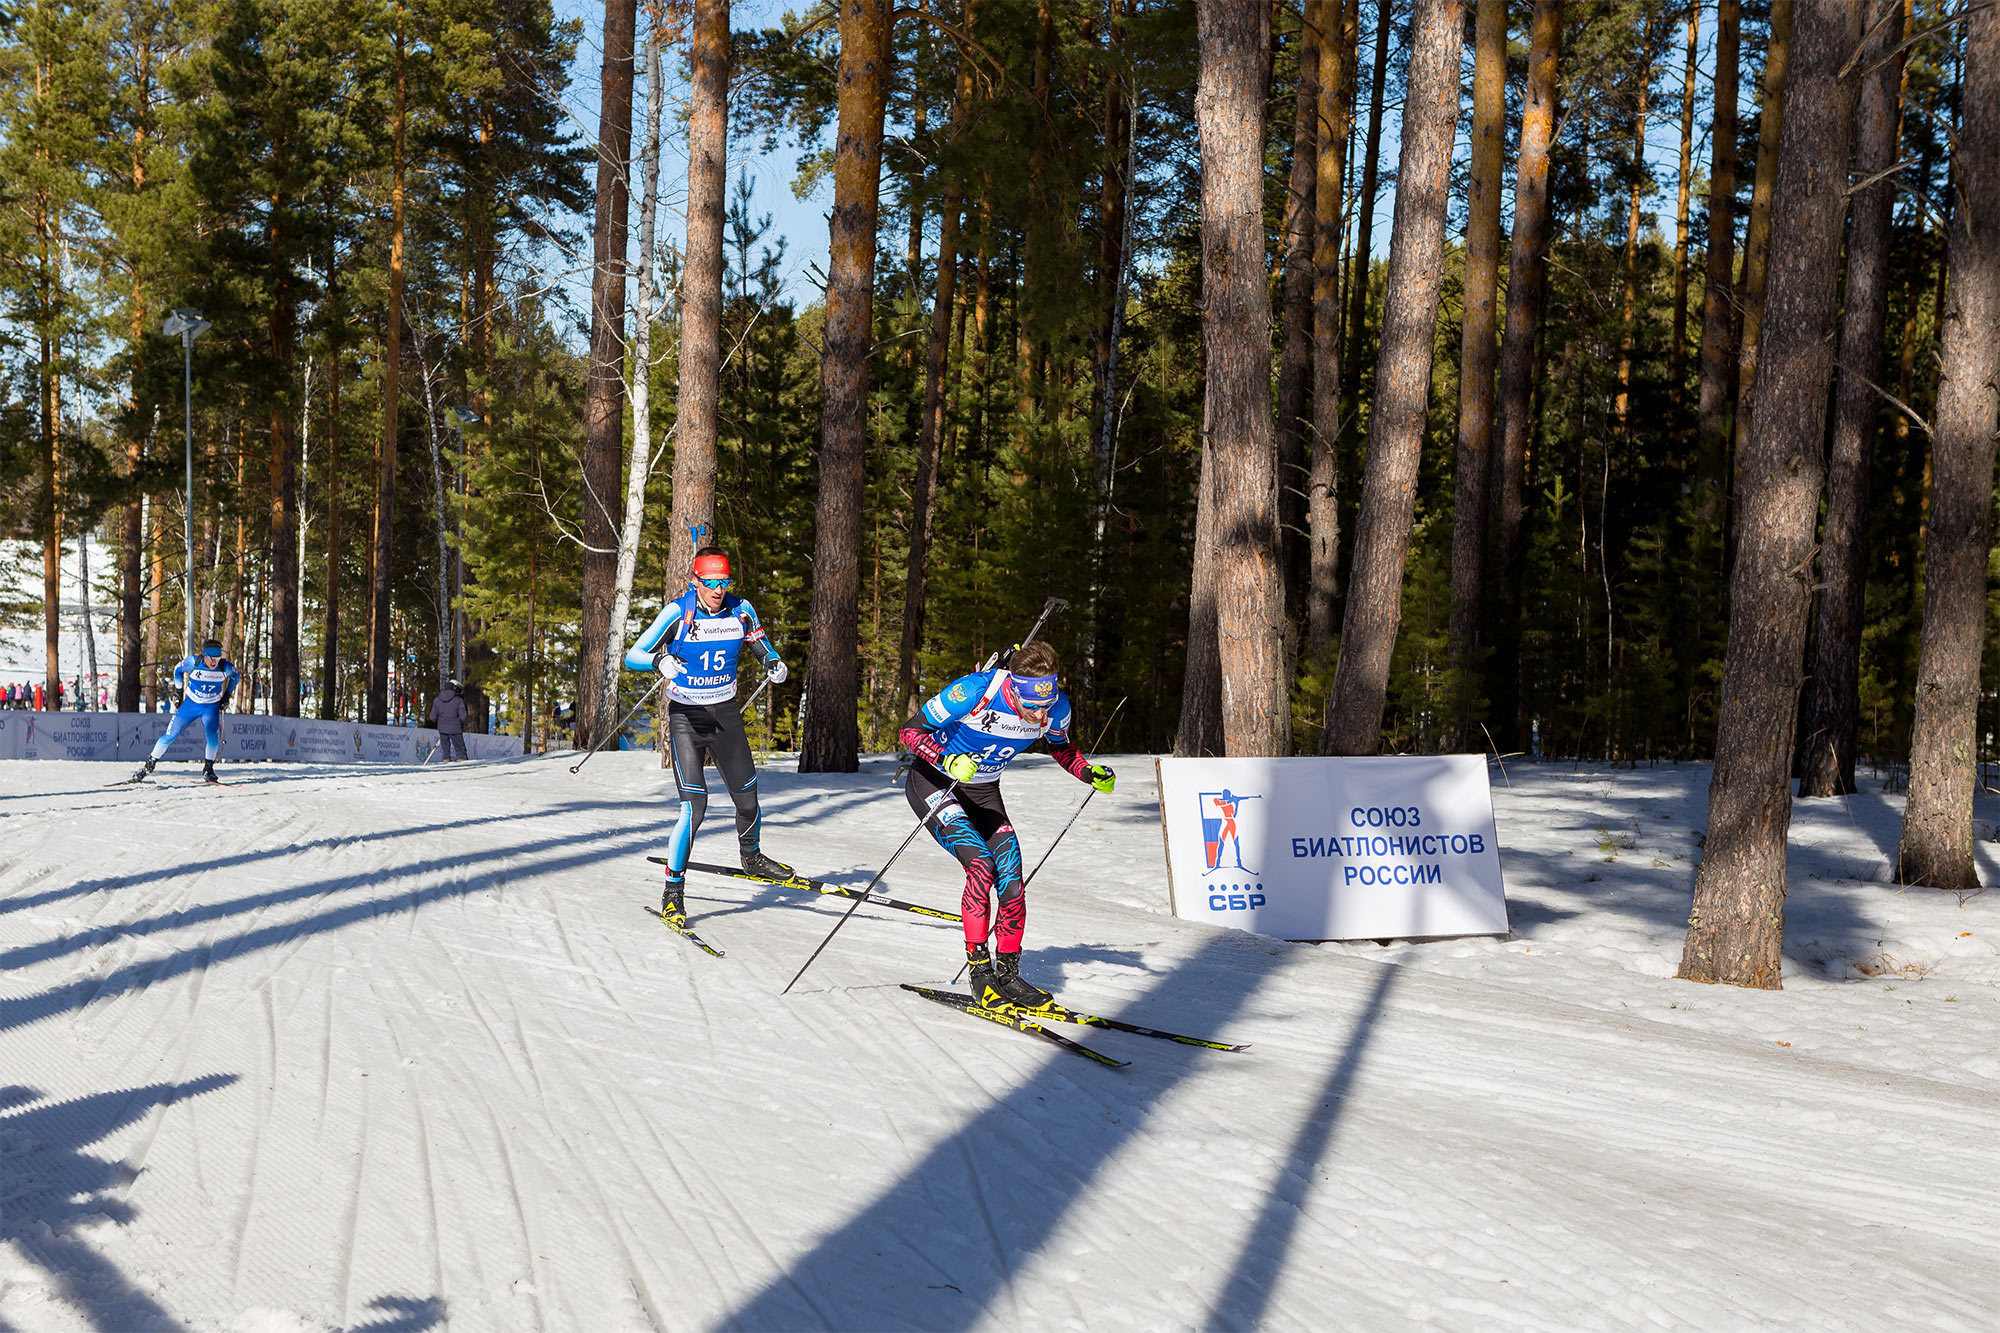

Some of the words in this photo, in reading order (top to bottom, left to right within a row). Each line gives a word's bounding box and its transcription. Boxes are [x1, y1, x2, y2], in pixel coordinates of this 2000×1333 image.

[703, 626, 739, 634] VisitTyumen
[699, 650, 727, 671] 15
[686, 674, 731, 687] ТЮМЕНЬ
[201, 684, 216, 692] 17
[71, 717, 91, 728] СОЮЗ
[232, 723, 274, 736] ЖЕМЧУЖИНА
[53, 731, 108, 742] БИАТЛОНИСТОВ
[66, 746, 95, 757] РОССИИ
[240, 739, 267, 750] СИБИРИ
[983, 744, 1015, 761] 19
[1350, 806, 1421, 827] СОЮЗ
[1291, 833, 1485, 858] БИАТЛОНИСТОВ
[1344, 864, 1442, 885] РОССИИ
[1208, 893, 1266, 911] СБР
[909, 906, 962, 922] FISCHER
[966, 1006, 1014, 1027] FISCHER
